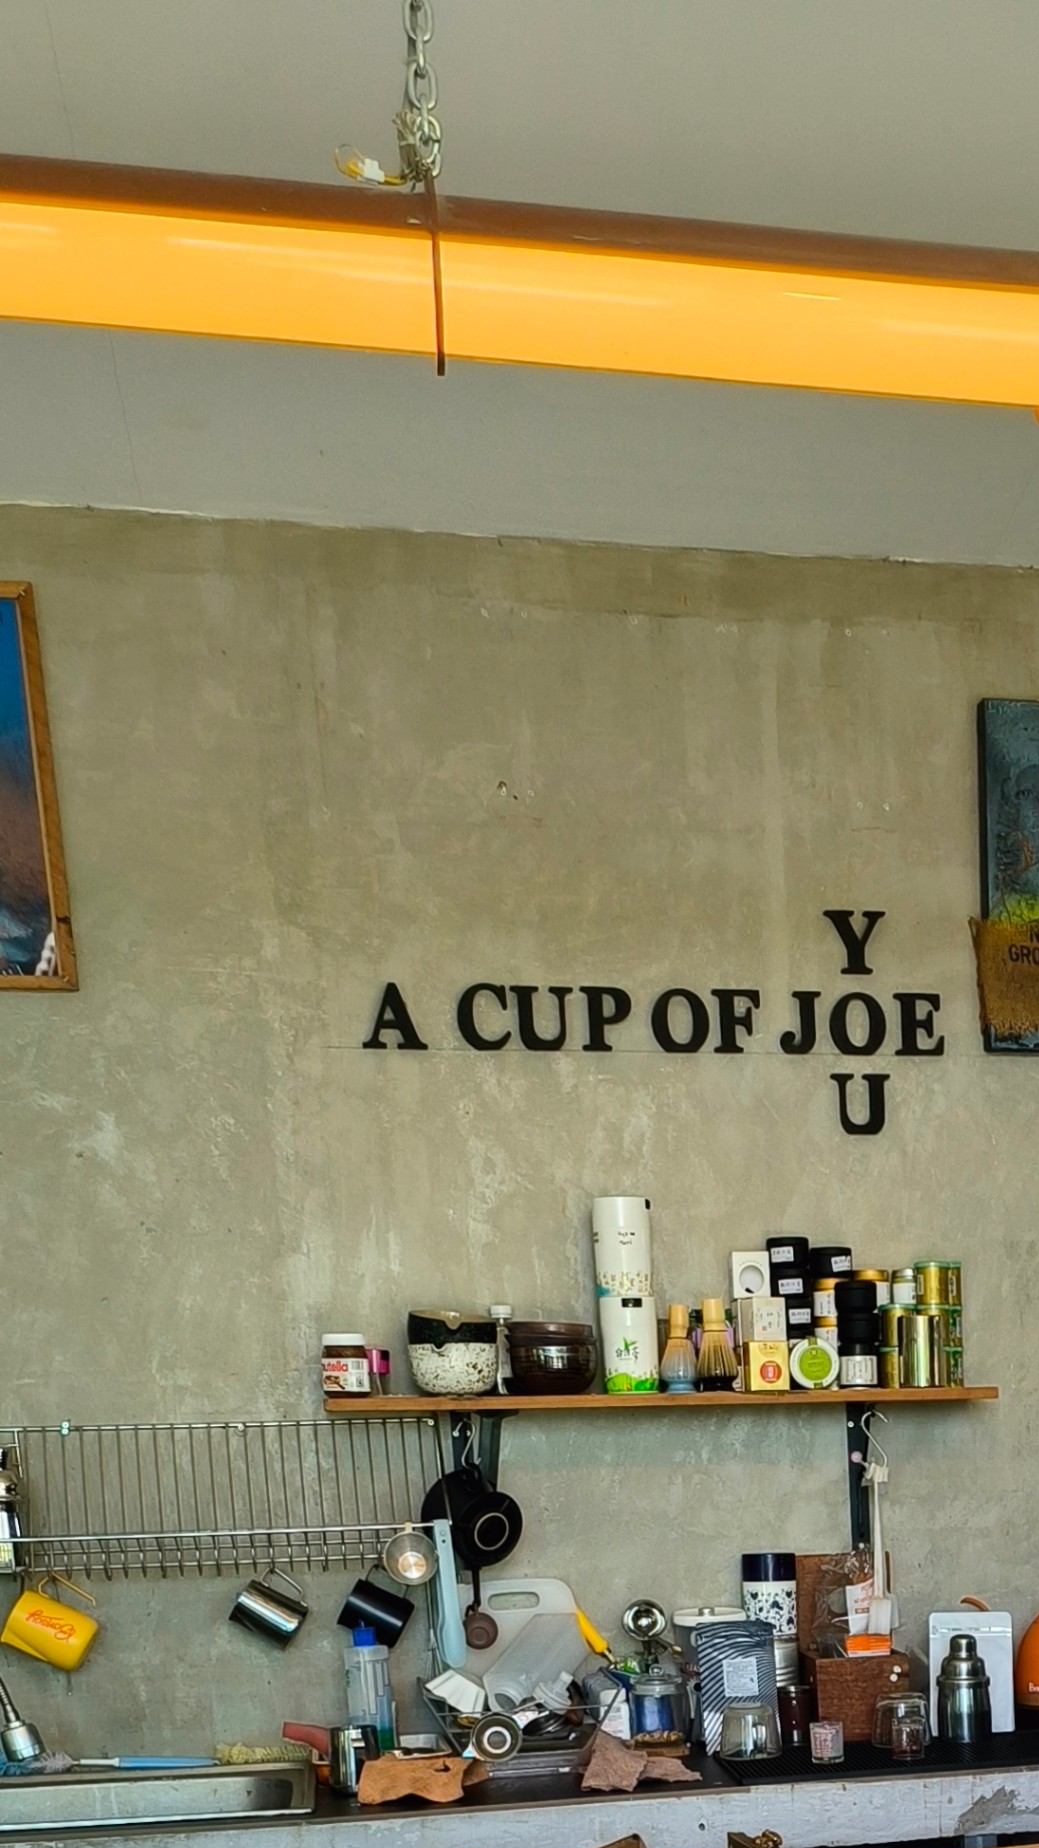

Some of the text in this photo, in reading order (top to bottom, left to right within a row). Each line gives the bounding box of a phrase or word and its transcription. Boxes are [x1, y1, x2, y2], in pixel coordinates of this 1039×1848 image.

[362, 982, 945, 1057] A CUP OF JOE
